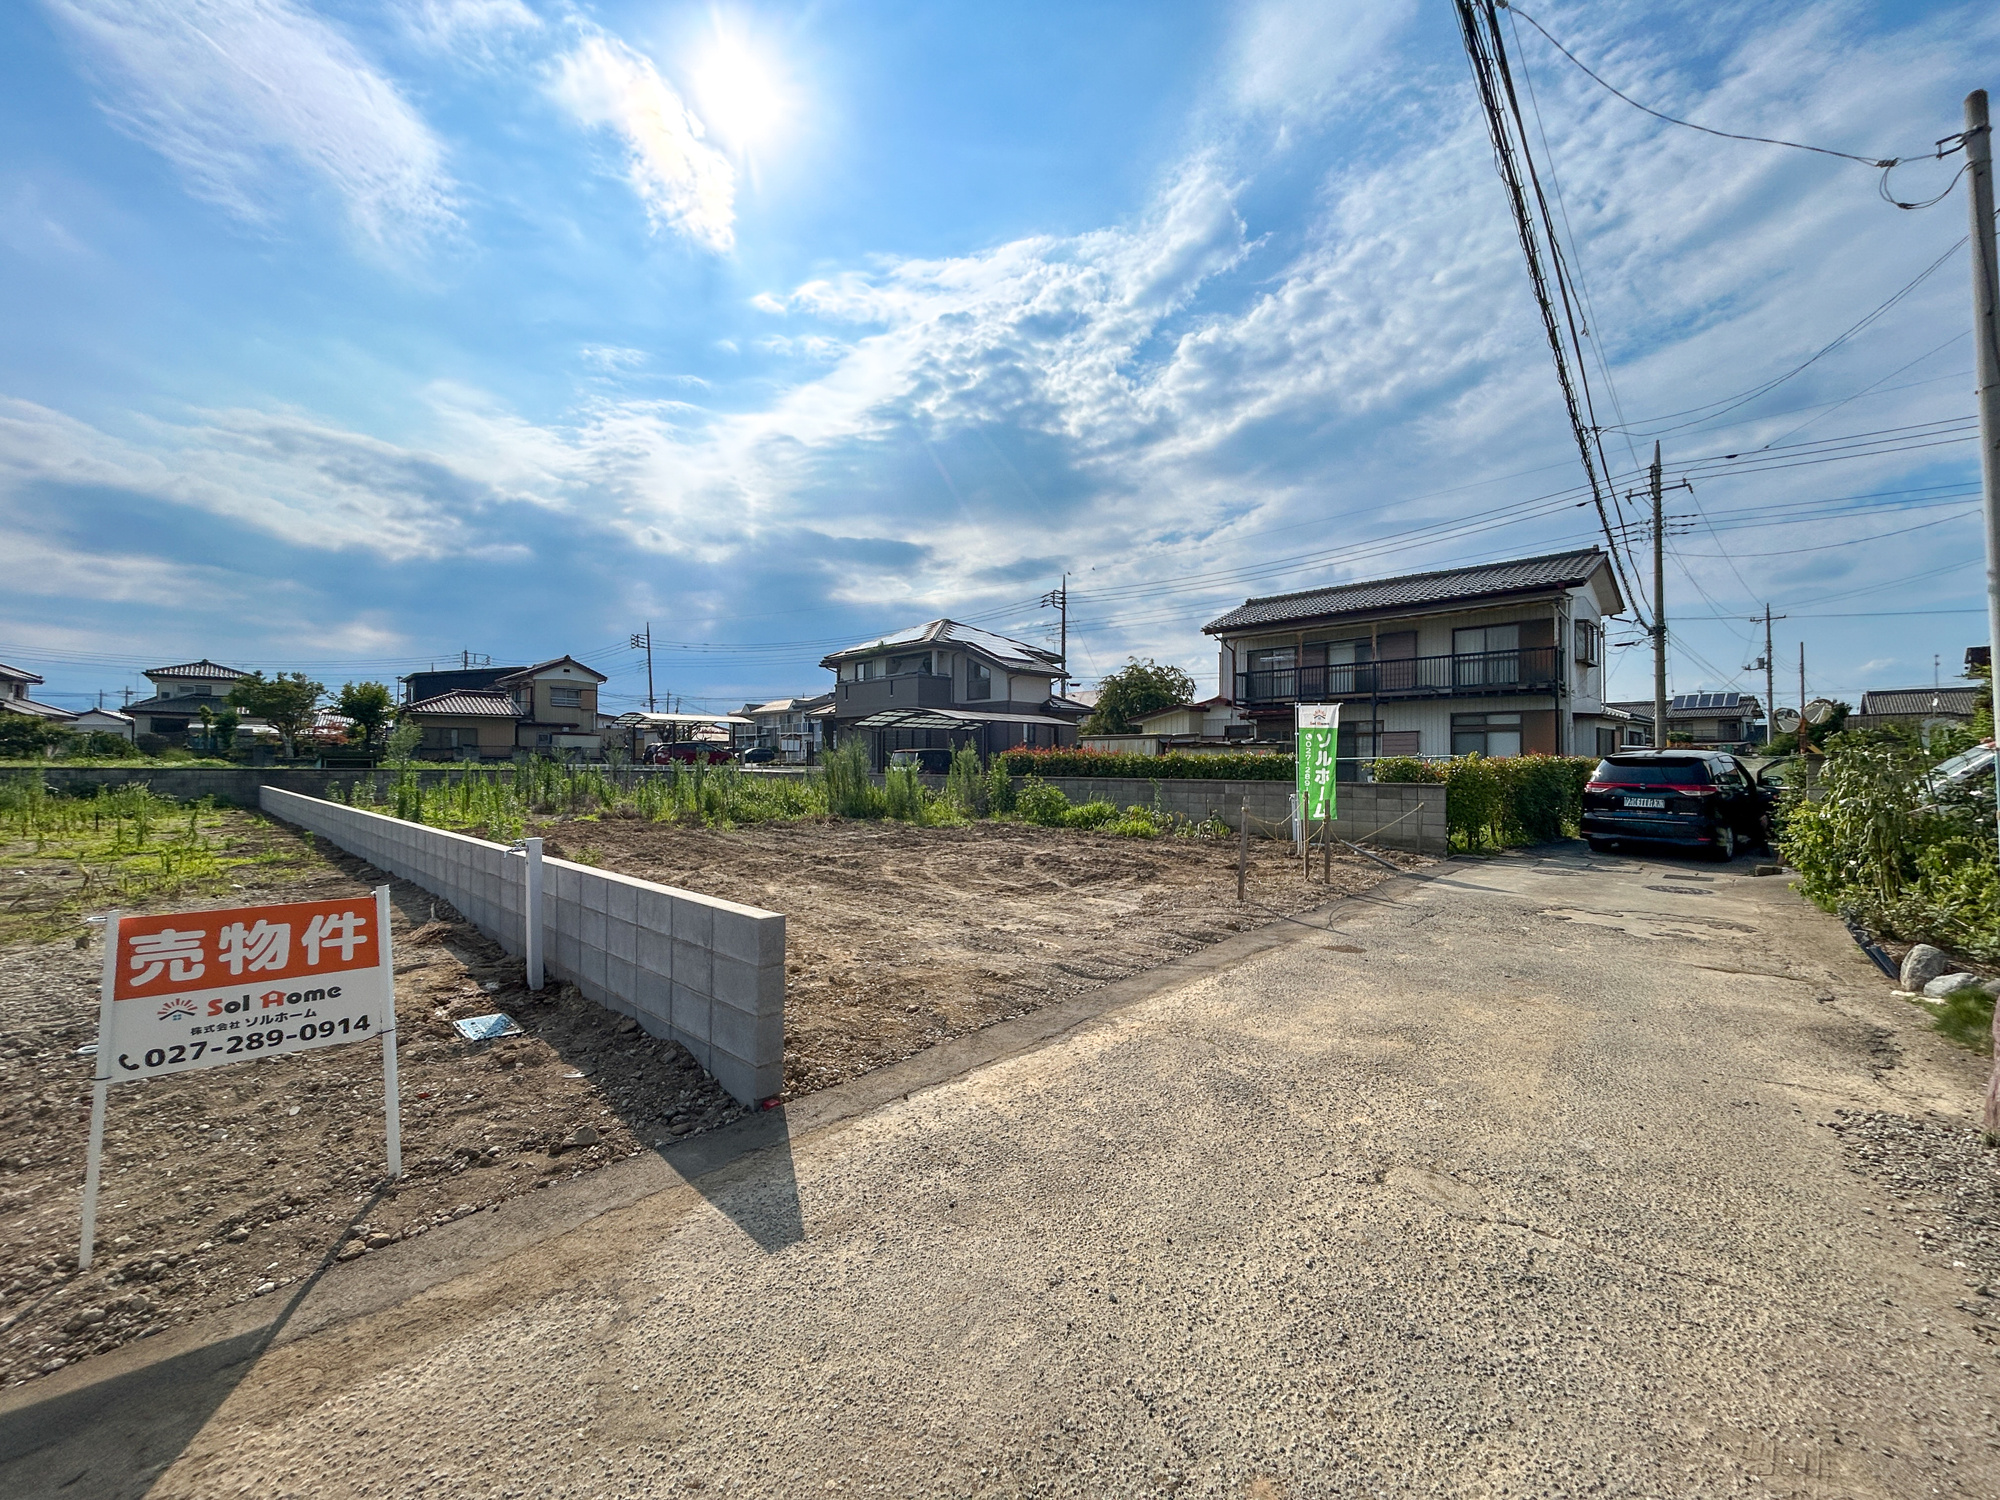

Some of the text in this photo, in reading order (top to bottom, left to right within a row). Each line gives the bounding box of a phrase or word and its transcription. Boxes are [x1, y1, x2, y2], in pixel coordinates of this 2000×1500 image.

[1313, 733, 1332, 818] ソルホーム
[129, 911, 368, 987] 売物件
[190, 1008, 317, 1036] 株式会社 ソルホーム
[207, 985, 342, 1017] Sol Home
[144, 1014, 371, 1068] 027-289-0914
